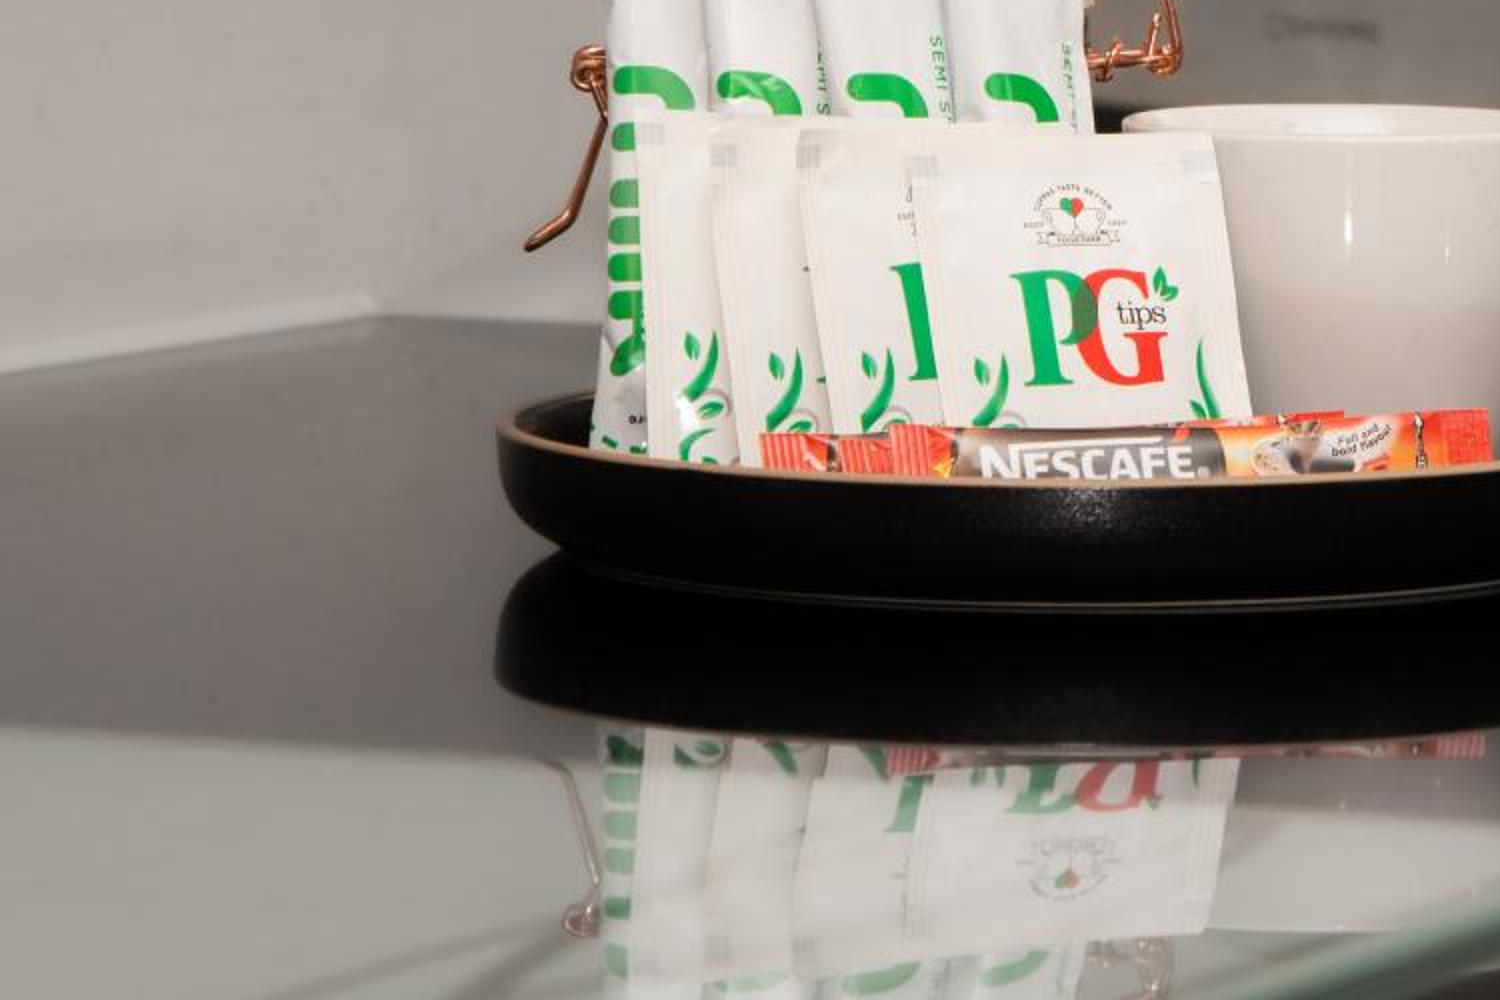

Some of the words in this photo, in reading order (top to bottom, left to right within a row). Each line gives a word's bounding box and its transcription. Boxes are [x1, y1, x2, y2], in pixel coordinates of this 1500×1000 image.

[929, 36, 948, 89] SEMI
[1010, 269, 1169, 387] PG
[1116, 301, 1167, 330] tips
